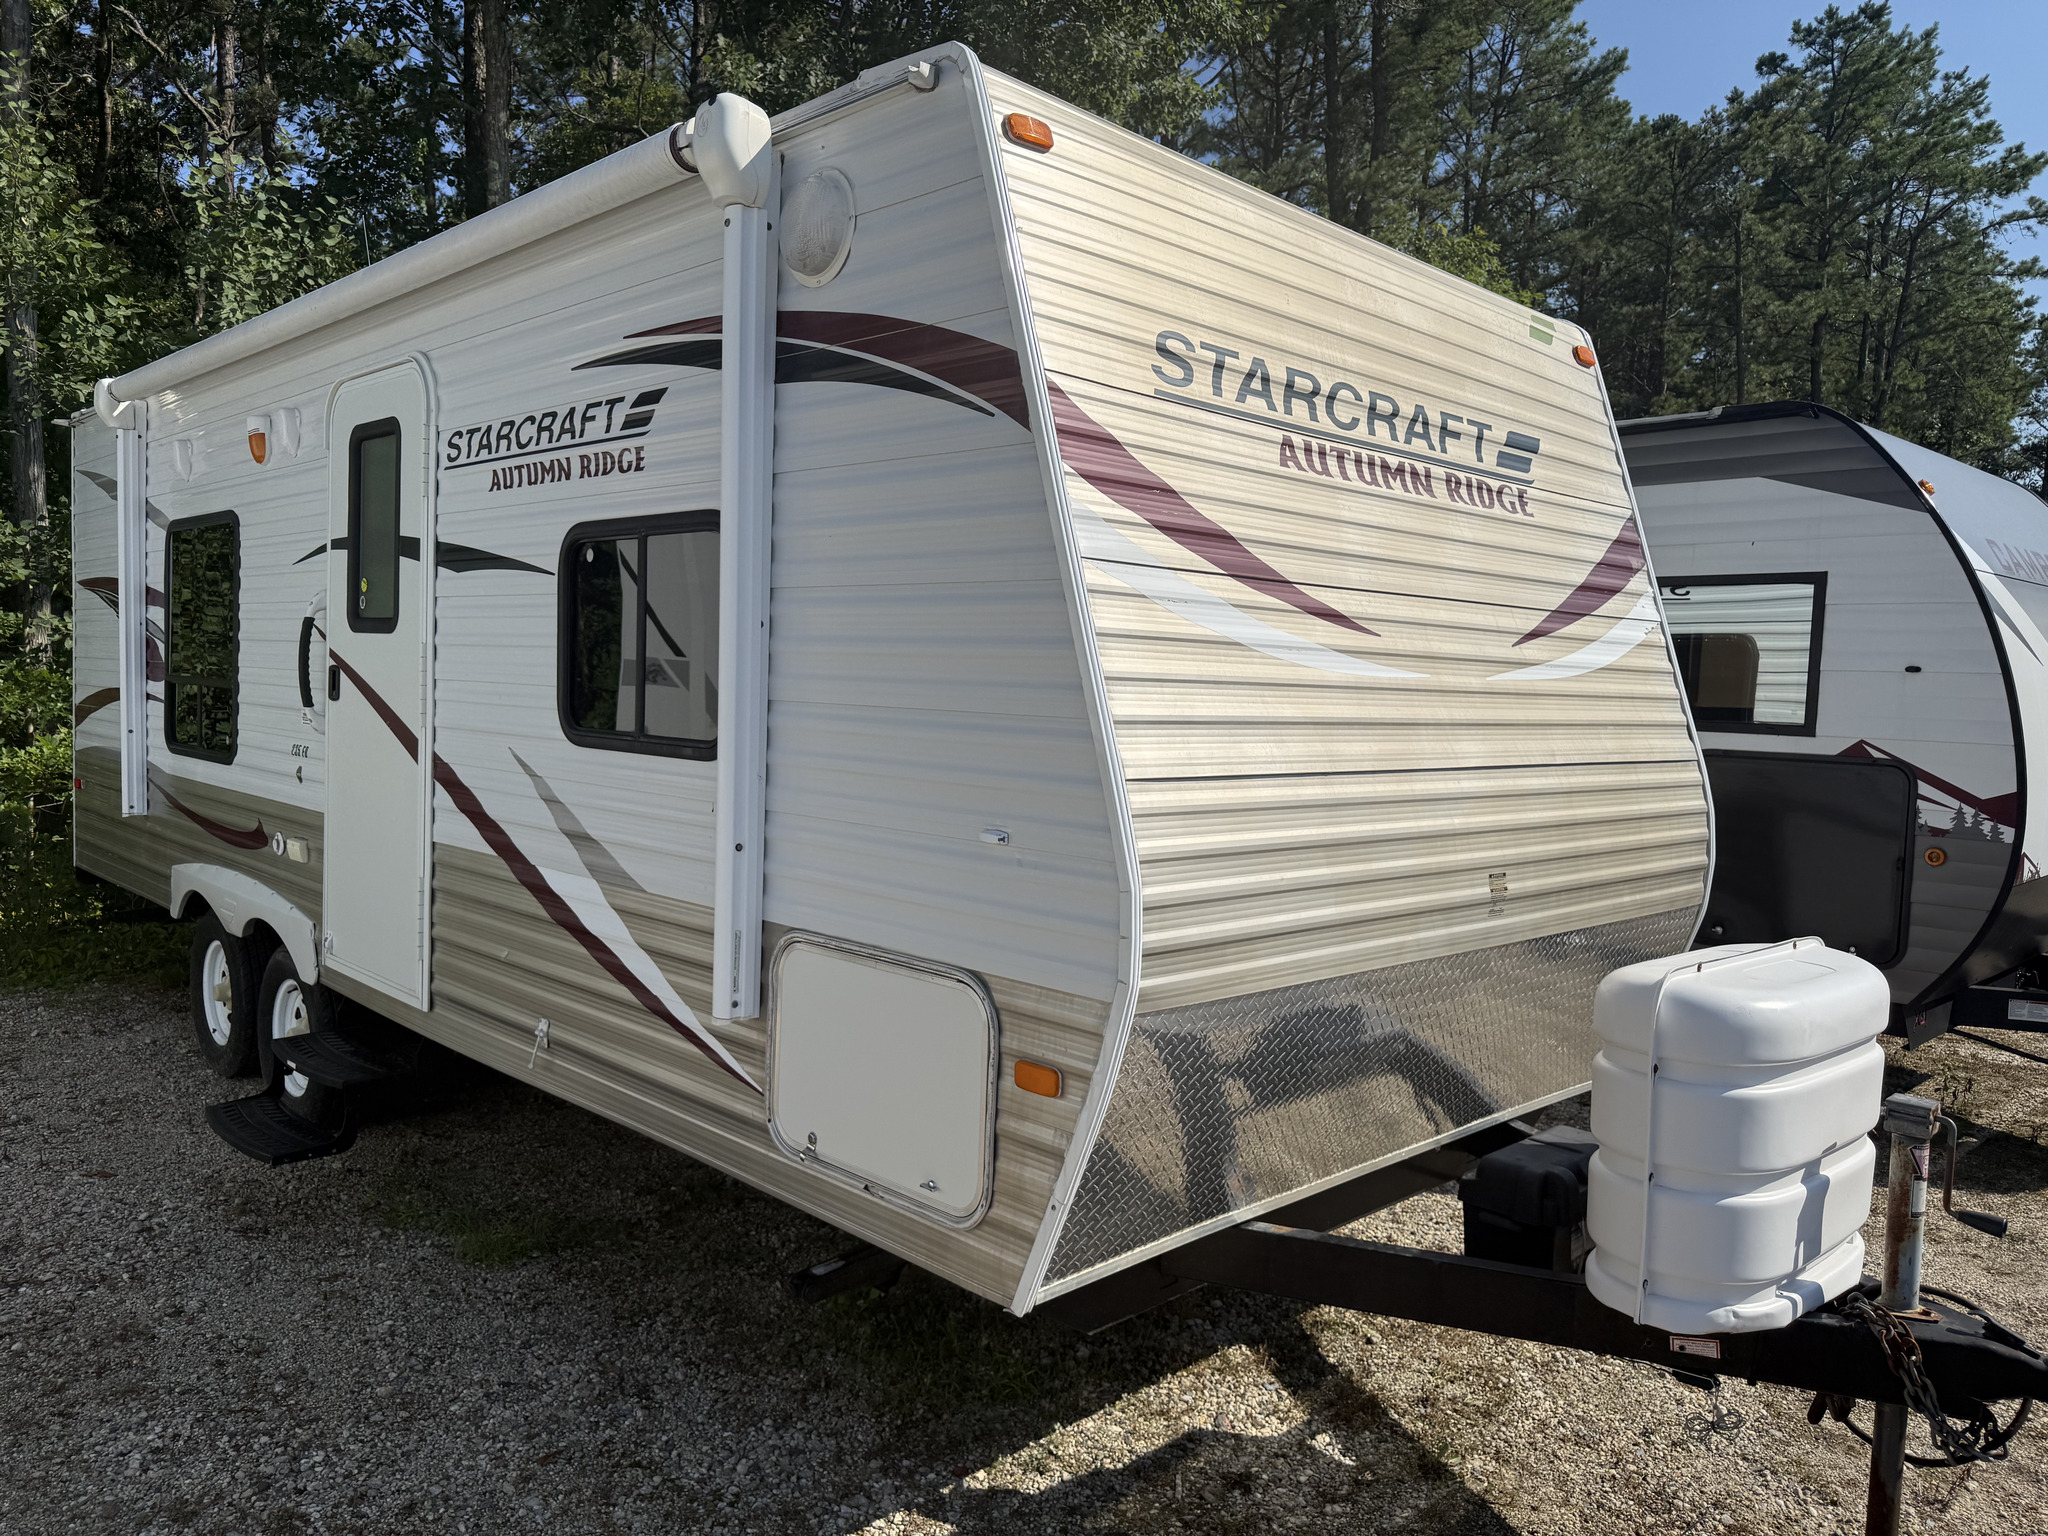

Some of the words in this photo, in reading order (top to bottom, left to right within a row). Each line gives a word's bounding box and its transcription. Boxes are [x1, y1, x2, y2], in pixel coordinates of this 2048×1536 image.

[446, 396, 626, 463] STARCRAFT
[1150, 330, 1493, 463] STARCRAFT
[488, 457, 571, 493] AUTUMN
[579, 445, 646, 479] RIDGE
[1279, 434, 1438, 499] AUTUMN
[1443, 470, 1535, 518] RIDGE
[1985, 538, 2048, 581] CAMP
